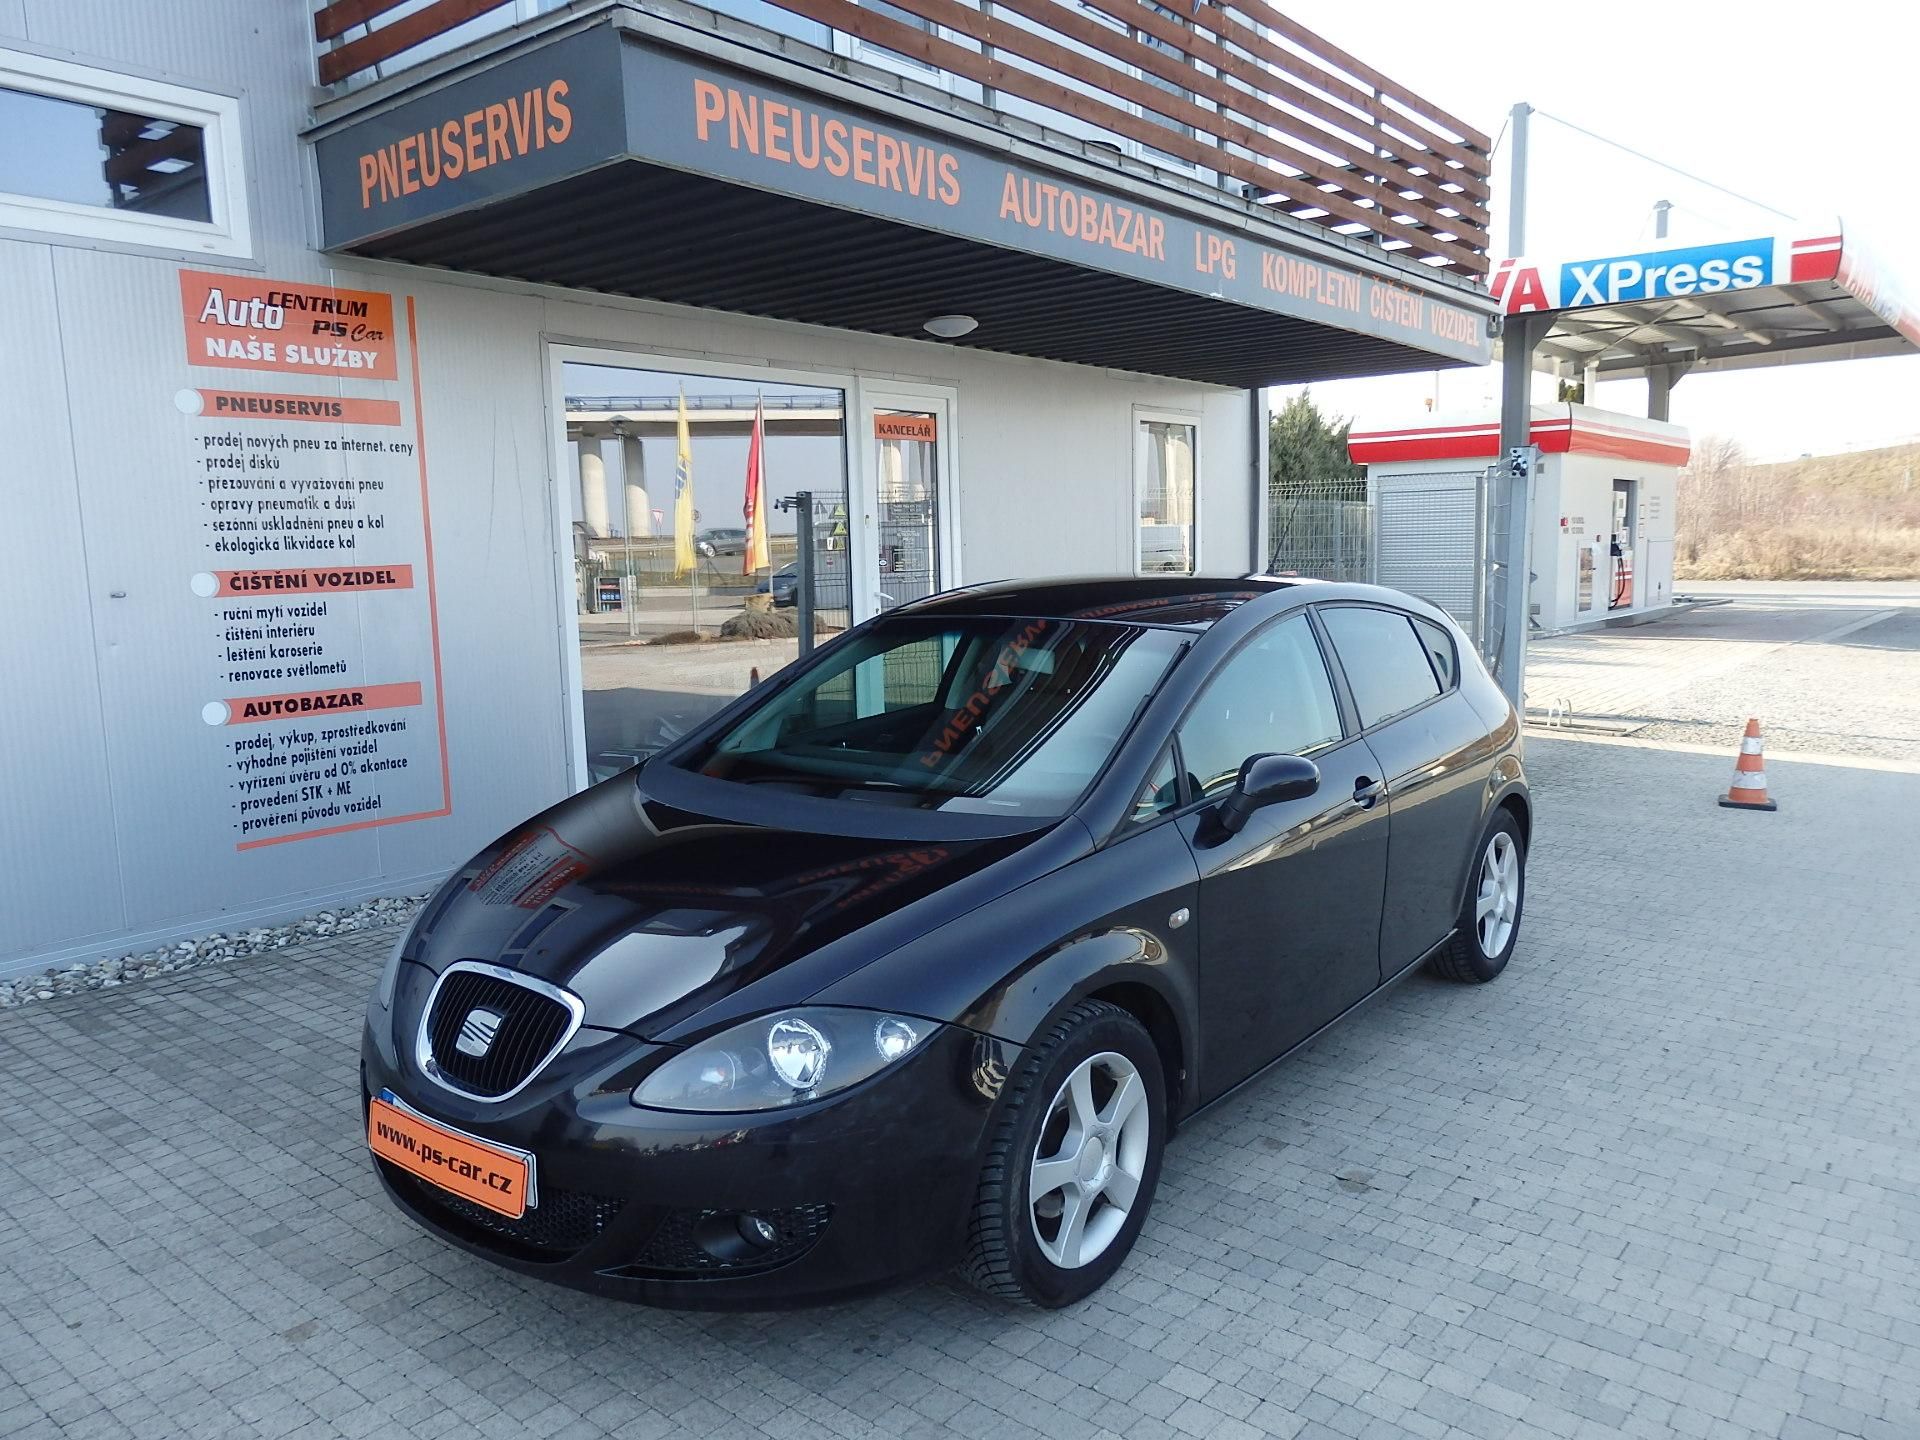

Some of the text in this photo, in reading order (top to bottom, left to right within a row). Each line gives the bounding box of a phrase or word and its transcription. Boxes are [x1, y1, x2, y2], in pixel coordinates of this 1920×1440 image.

[358, 78, 572, 208] PNEUSERVIS
[694, 78, 1480, 348] PNEUSERVIS AUTOBAZAR LPG KOMPLETNÍ ČIŠTĚNÍ VOZIDEL
[1568, 254, 1764, 308] XPress
[199, 287, 369, 330] Auto CENTRUM
[312, 319, 386, 343] PS Car
[206, 335, 378, 370] NAŠE SLUŽBY
[216, 396, 343, 417] PNEUSERVIS
[878, 423, 931, 437] KANCELÁŘ
[204, 432, 413, 456] prodej nových pneu za internet. ceny
[206, 453, 280, 472] prodej disků
[208, 476, 384, 493] přezouvání a vyvažování pneu
[211, 500, 253, 514] opravy
[258, 495, 319, 513] pneumatik
[324, 500, 330, 510] a
[213, 515, 384, 533] sezónní uskladnění pneu a kol
[215, 535, 355, 554] ekologická likvidace kol
[230, 570, 396, 591] ČIŠTĚNÍ VOZIDEL
[223, 605, 252, 621] ruční
[287, 602, 327, 617] vozidel
[225, 623, 315, 642] čištění interiéru
[227, 642, 323, 662] leštění karoserie
[229, 660, 347, 682] renovace světlometů
[243, 692, 364, 718] AUTOBAZAR
[235, 718, 406, 754] prodej, výkup, zprostředkování
[237, 739, 378, 774] výhodné pojištění vozidel
[238, 757, 407, 794] vyřízení úvěru od 0% akontace
[241, 790, 298, 815] provedení
[301, 785, 323, 801] STK
[336, 781, 351, 796] ME
[242, 795, 381, 834] prověření původu vozidel
[376, 1120, 513, 1195] www.ps-car.cz
